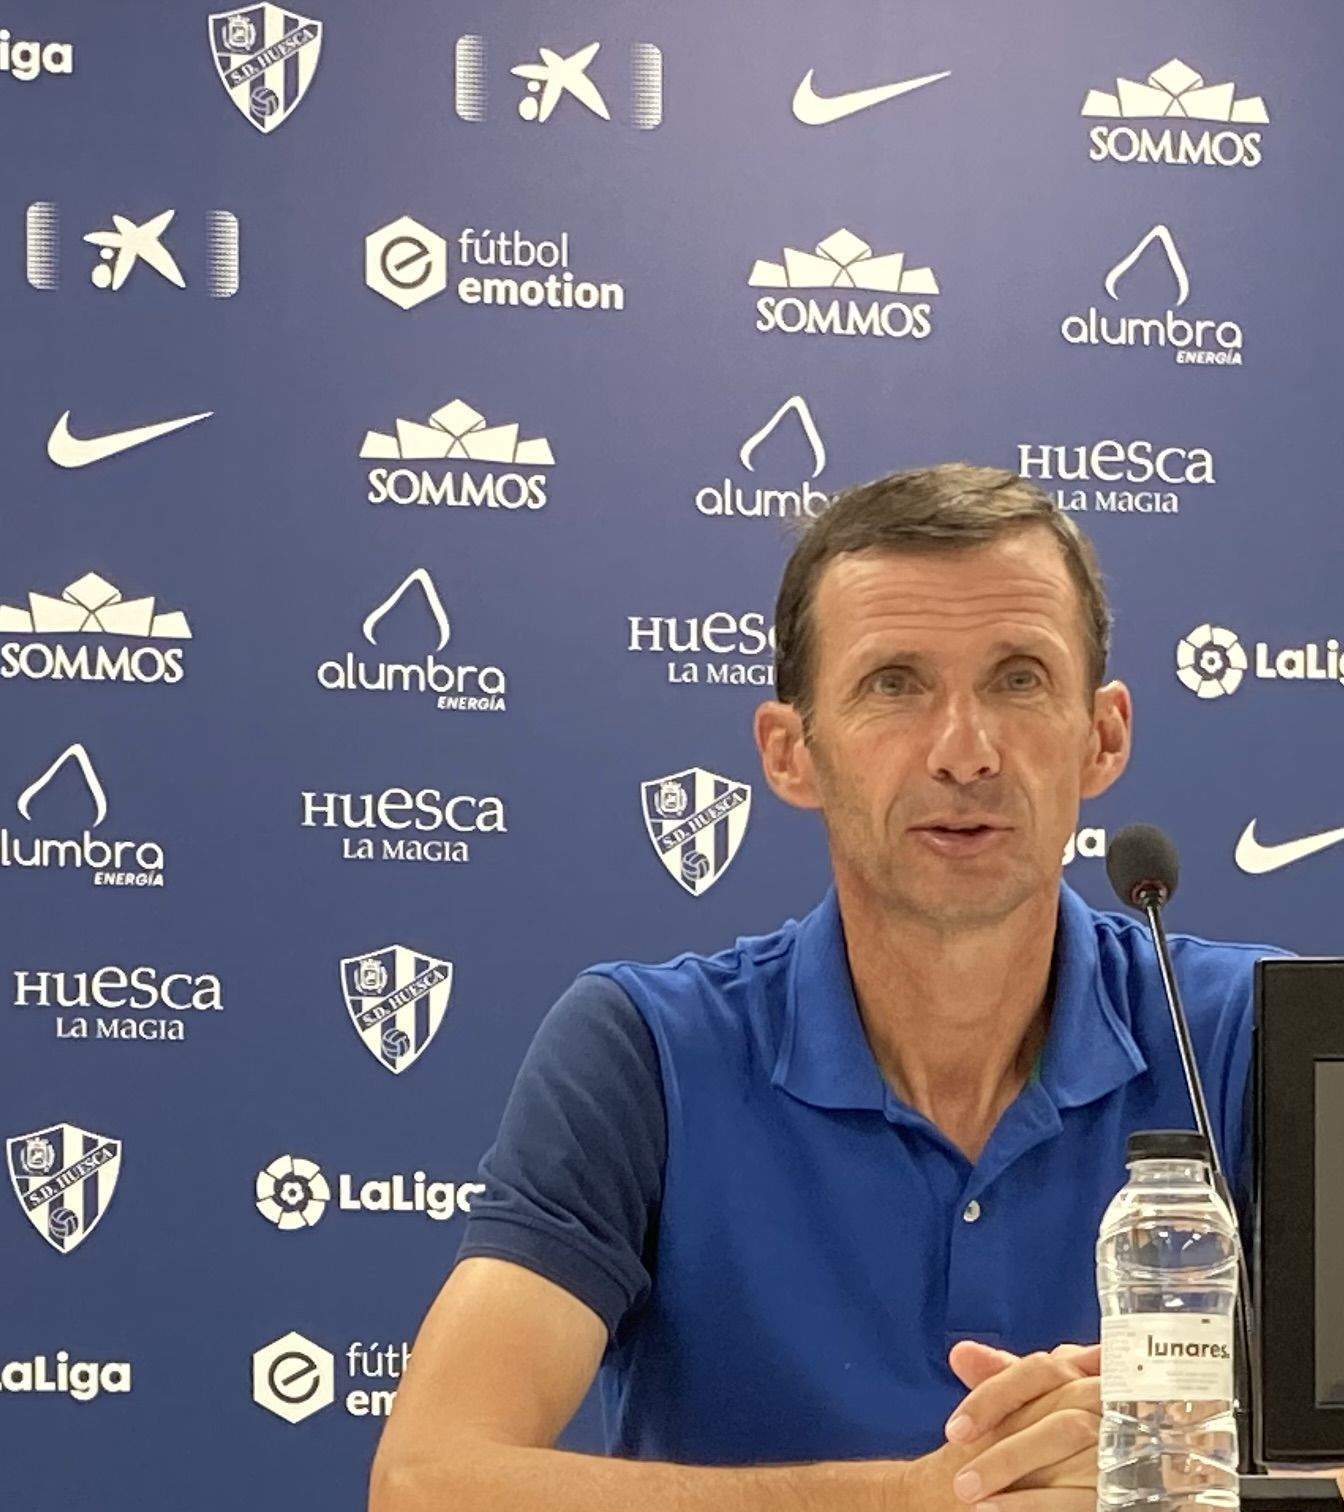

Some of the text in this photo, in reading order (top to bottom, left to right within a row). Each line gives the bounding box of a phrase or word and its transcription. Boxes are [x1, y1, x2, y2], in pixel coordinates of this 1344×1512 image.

[1090, 126, 1261, 166] SOMMOS
[458, 229, 567, 267] fútbol
[458, 272, 623, 309] emotion
[757, 297, 930, 338] SOMMOS
[1062, 307, 1242, 348] alumbra
[368, 469, 546, 509] SOMMOS
[696, 478, 829, 518] alumb
[628, 612, 776, 654] Hues
[1, 643, 183, 682] SOMMOS
[318, 652, 505, 693] alumbra
